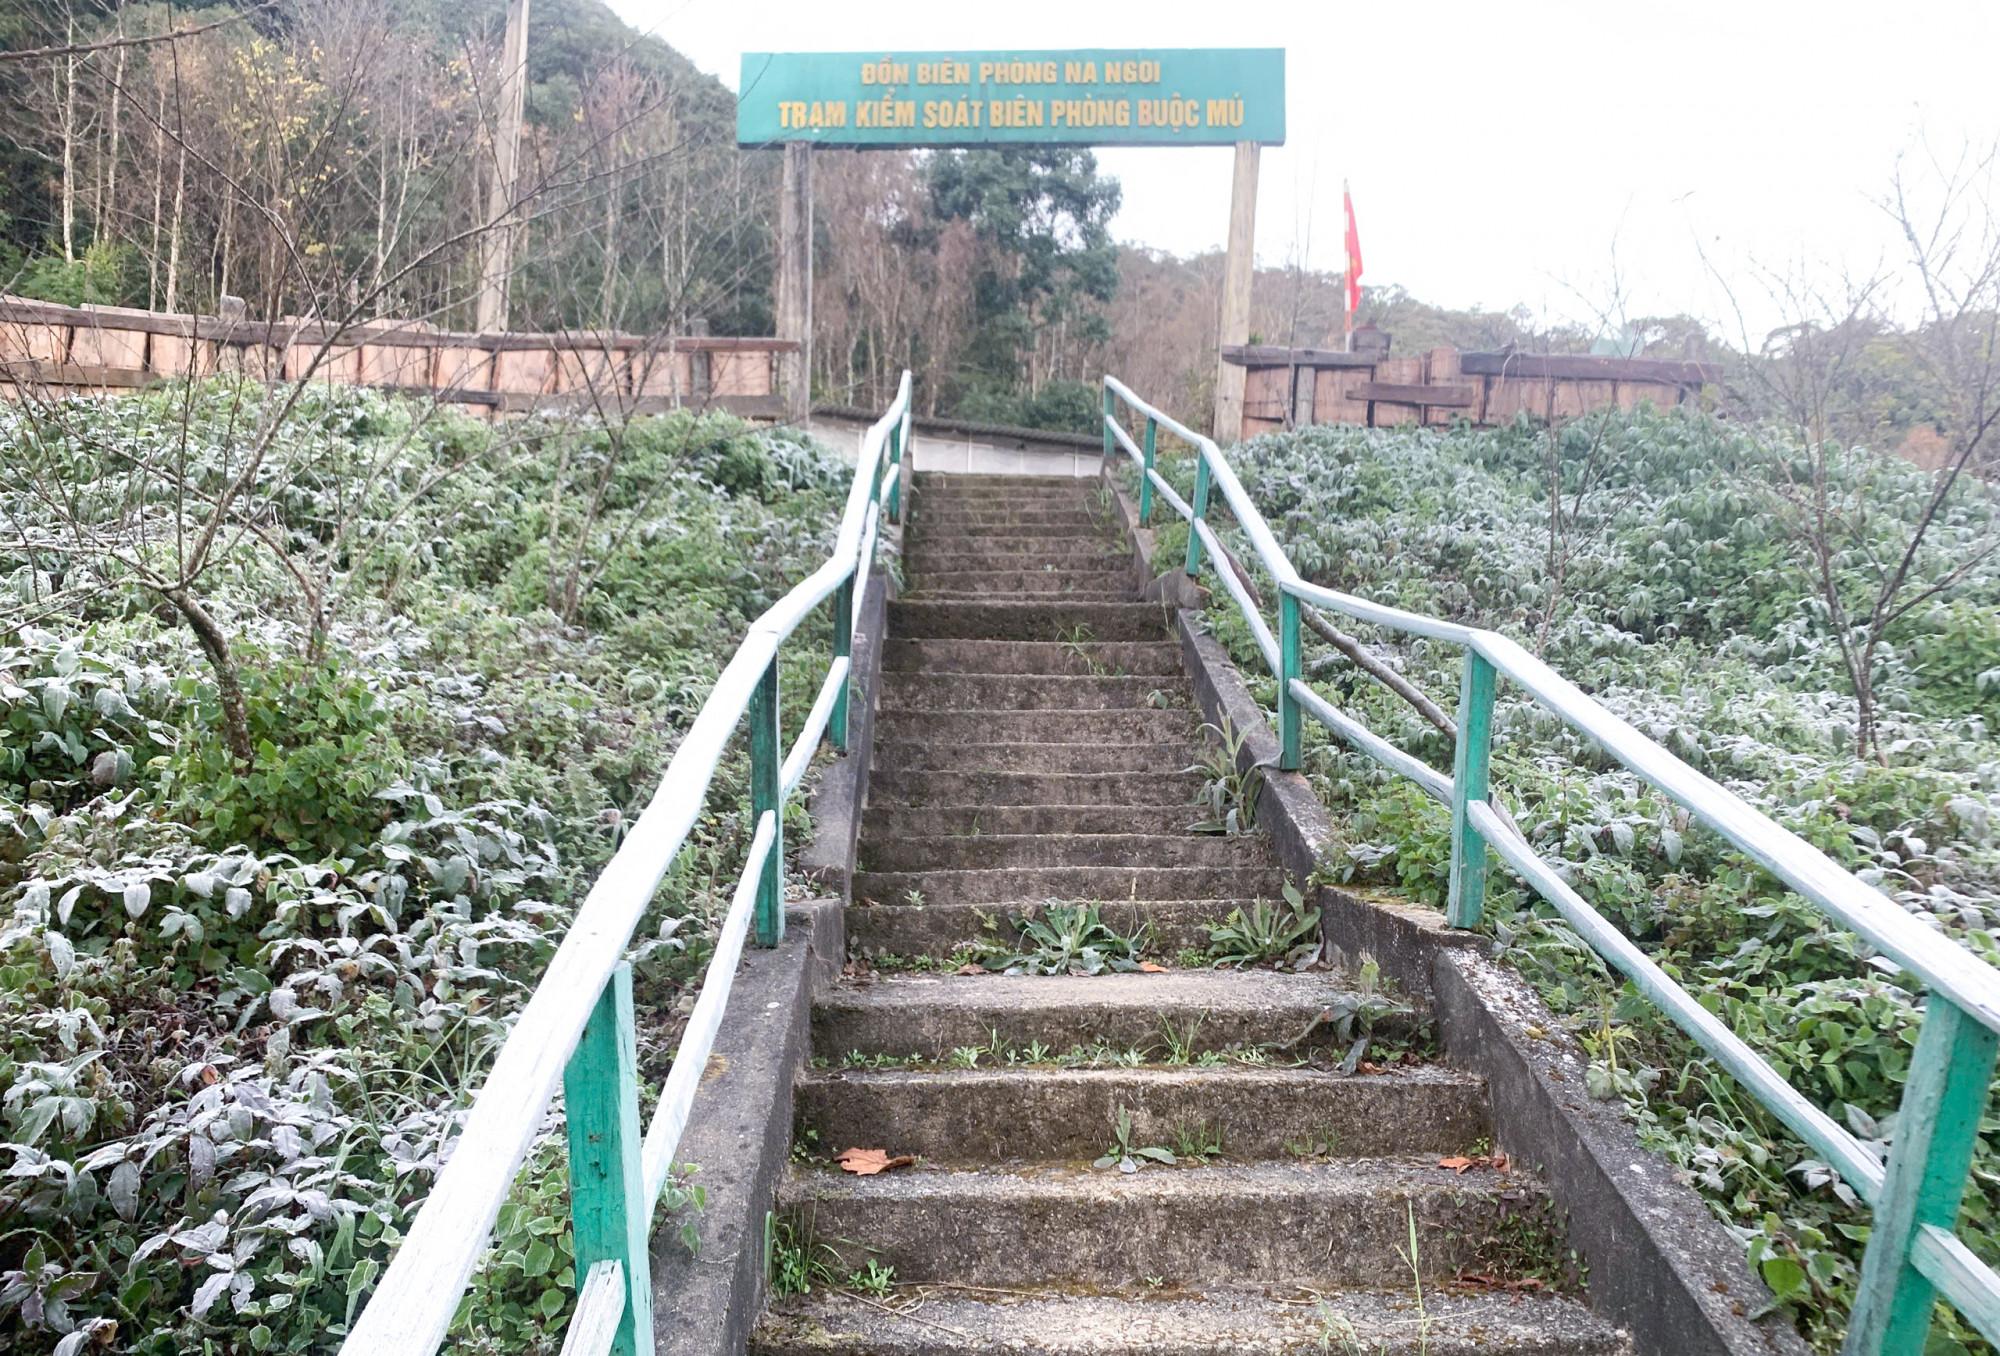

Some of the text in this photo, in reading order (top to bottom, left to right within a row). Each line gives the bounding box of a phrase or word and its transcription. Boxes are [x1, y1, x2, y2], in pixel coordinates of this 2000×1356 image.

[917, 57, 970, 85] BIÊN
[979, 56, 1057, 84] PHÒNG
[1064, 61, 1099, 84] NA
[1104, 61, 1161, 84] NGOI
[856, 87, 915, 128] KIỂM
[923, 94, 983, 128] SOÁT
[990, 94, 1044, 128] BIÊN
[1051, 93, 1130, 128] PHÒNG
[1137, 92, 1200, 134] BUỘC
[1206, 92, 1244, 128] MÚ
